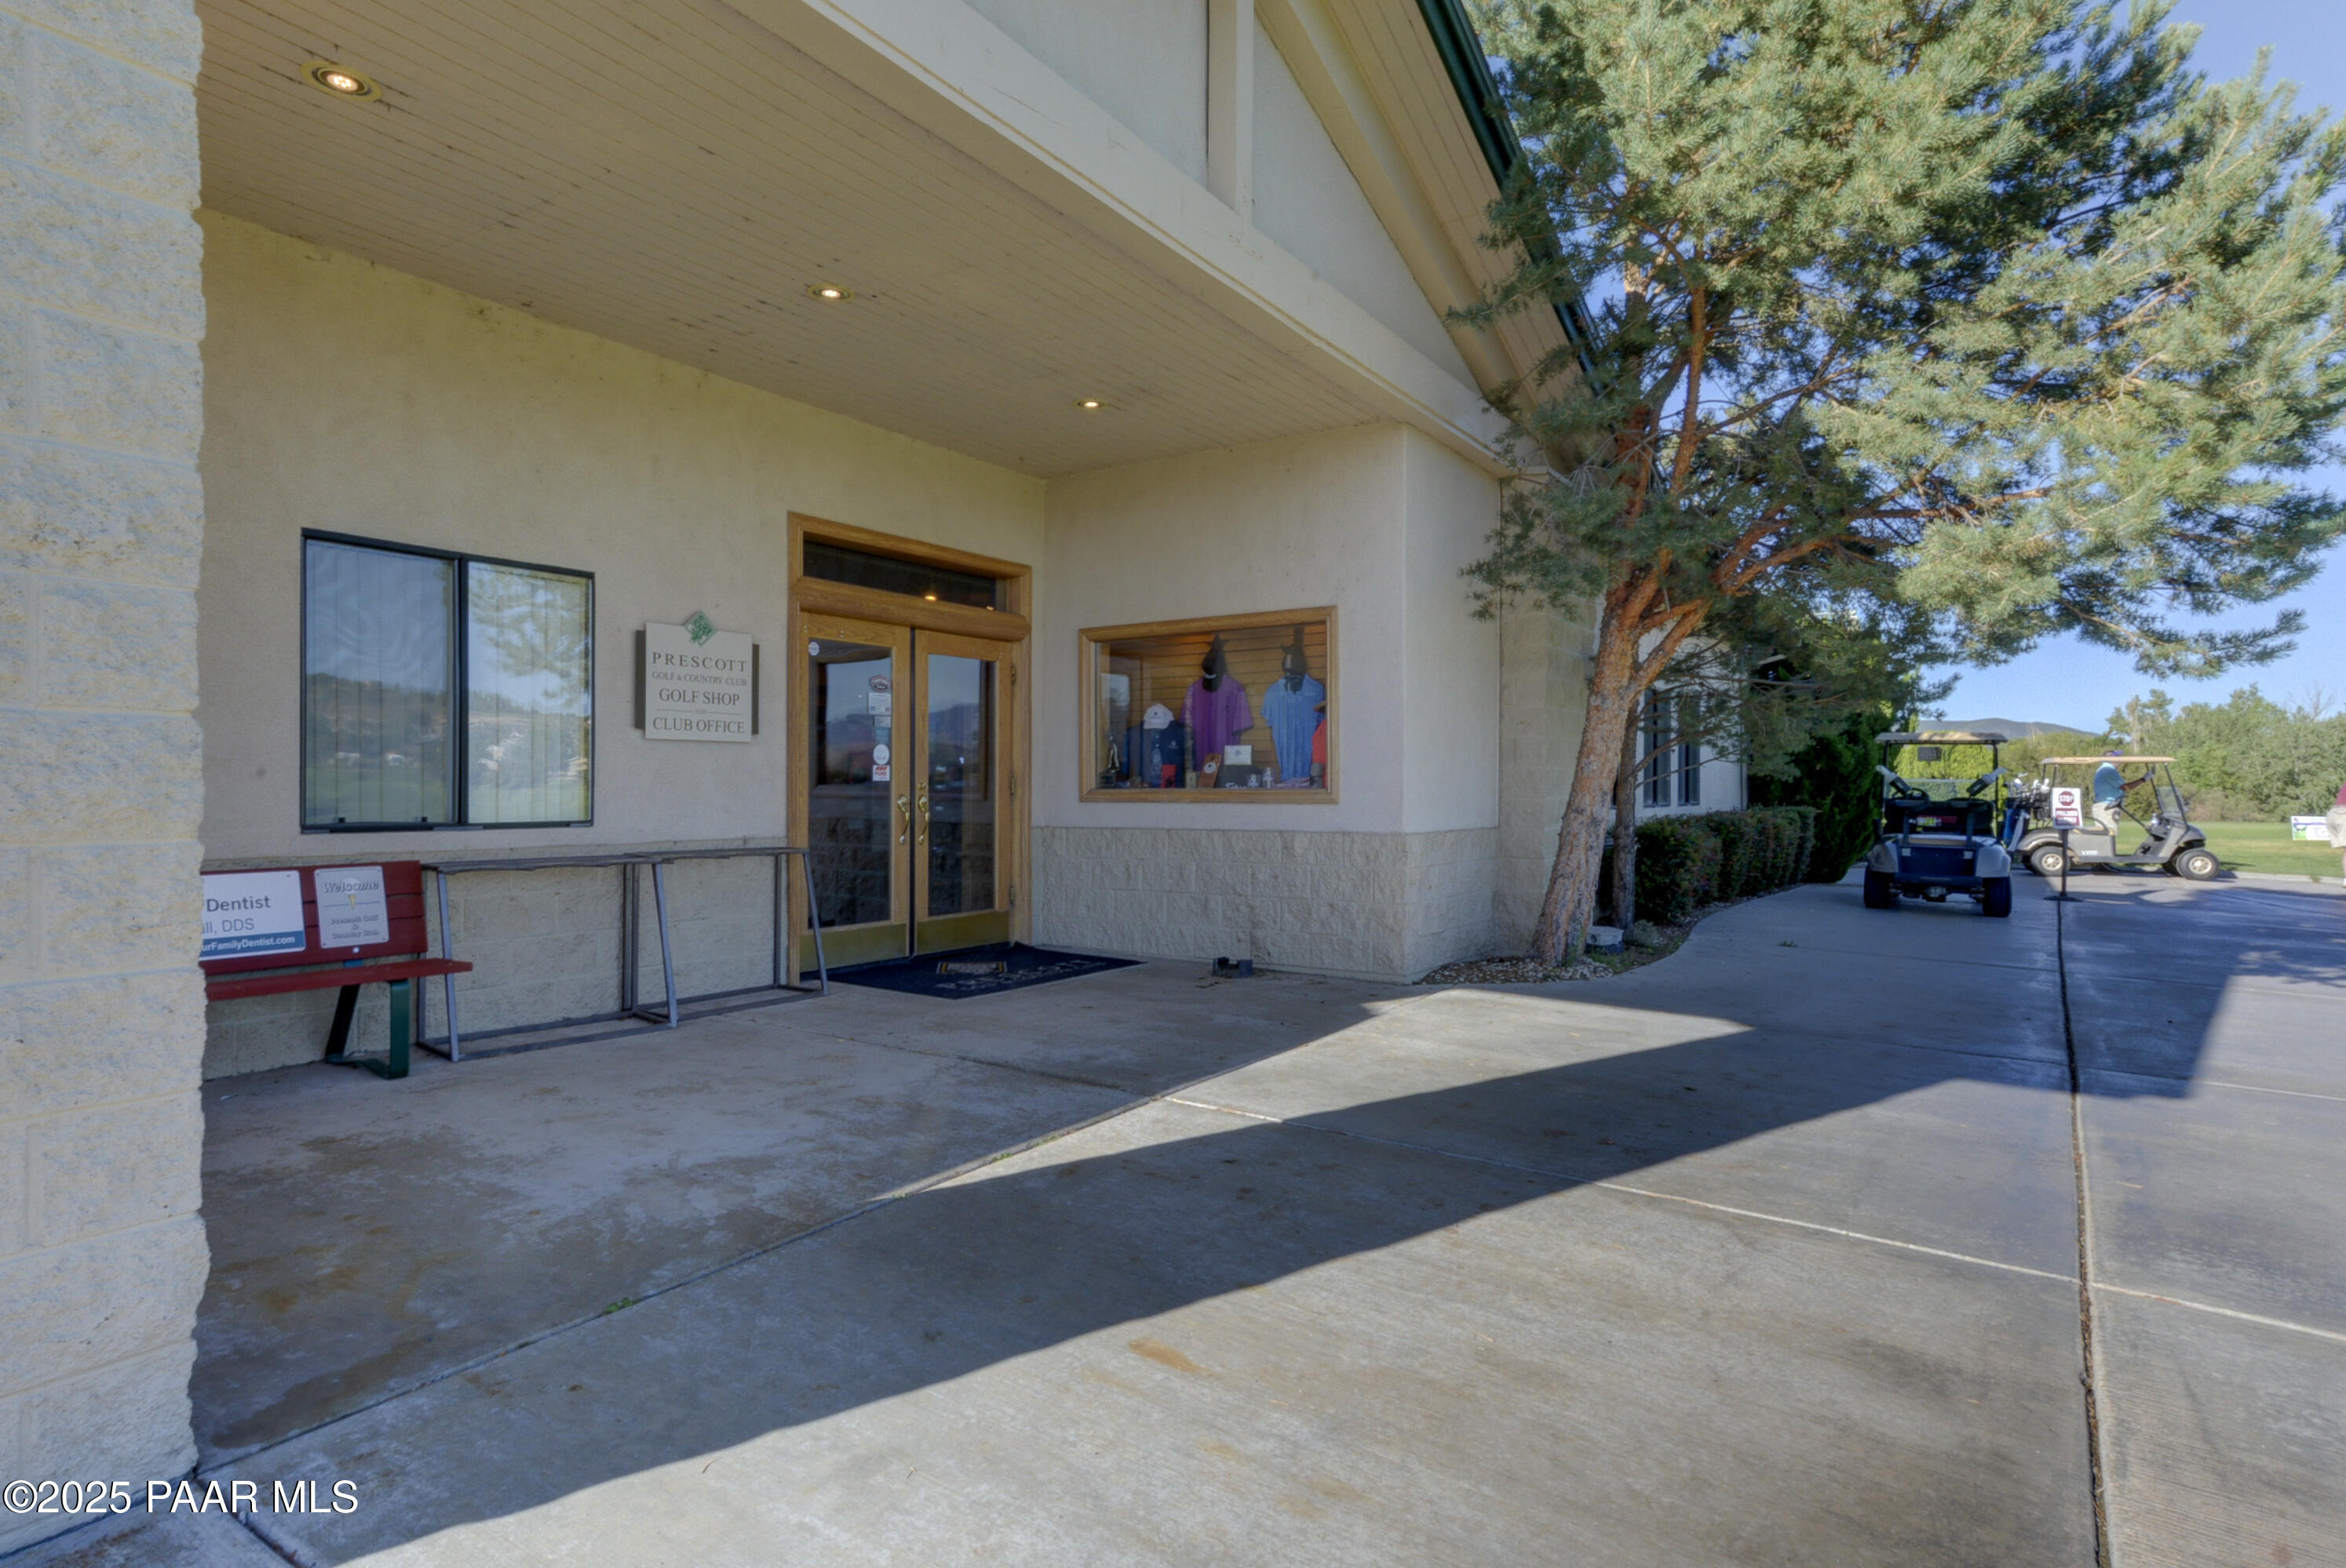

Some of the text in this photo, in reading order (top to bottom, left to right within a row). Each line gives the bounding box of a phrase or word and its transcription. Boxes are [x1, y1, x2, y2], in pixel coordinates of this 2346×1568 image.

[652, 652, 747, 672] PRESCOTT
[652, 671, 674, 681] GOLF
[684, 673, 722, 684] COUNTRY
[725, 677, 747, 686] CLUB
[659, 688, 740, 706] GOLF SHOP
[653, 717, 745, 734] CLUB OFFICE
[323, 881, 379, 894] Welcome
[206, 895, 271, 912] Dentist
[222, 917, 255, 932] DDS
[202, 936, 296, 951] urFamilyDentist.com
